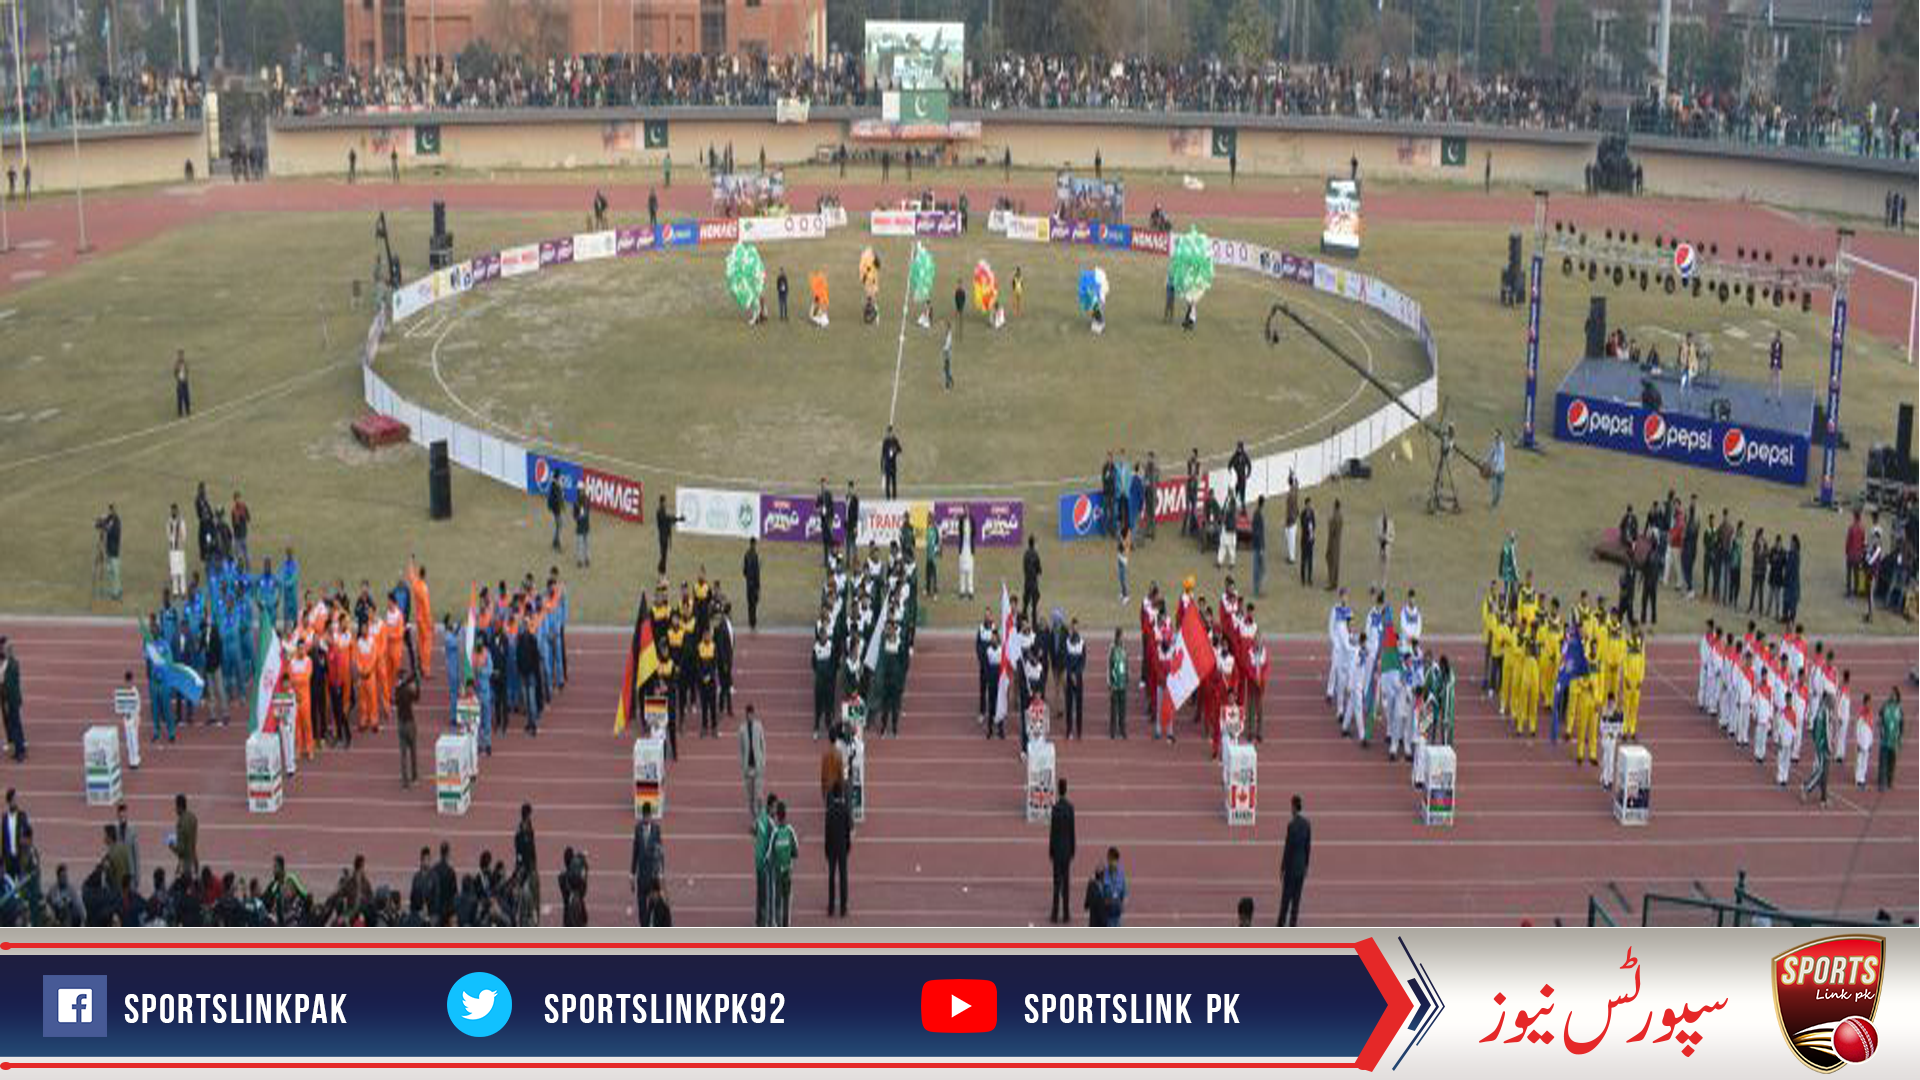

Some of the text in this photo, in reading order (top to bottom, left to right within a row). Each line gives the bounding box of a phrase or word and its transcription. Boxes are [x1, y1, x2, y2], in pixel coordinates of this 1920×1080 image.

[1590, 411, 1633, 436] pepsi
[1667, 426, 1712, 451] pepsi
[1747, 441, 1794, 466] pepsi
[585, 475, 640, 515] HOMAGE
